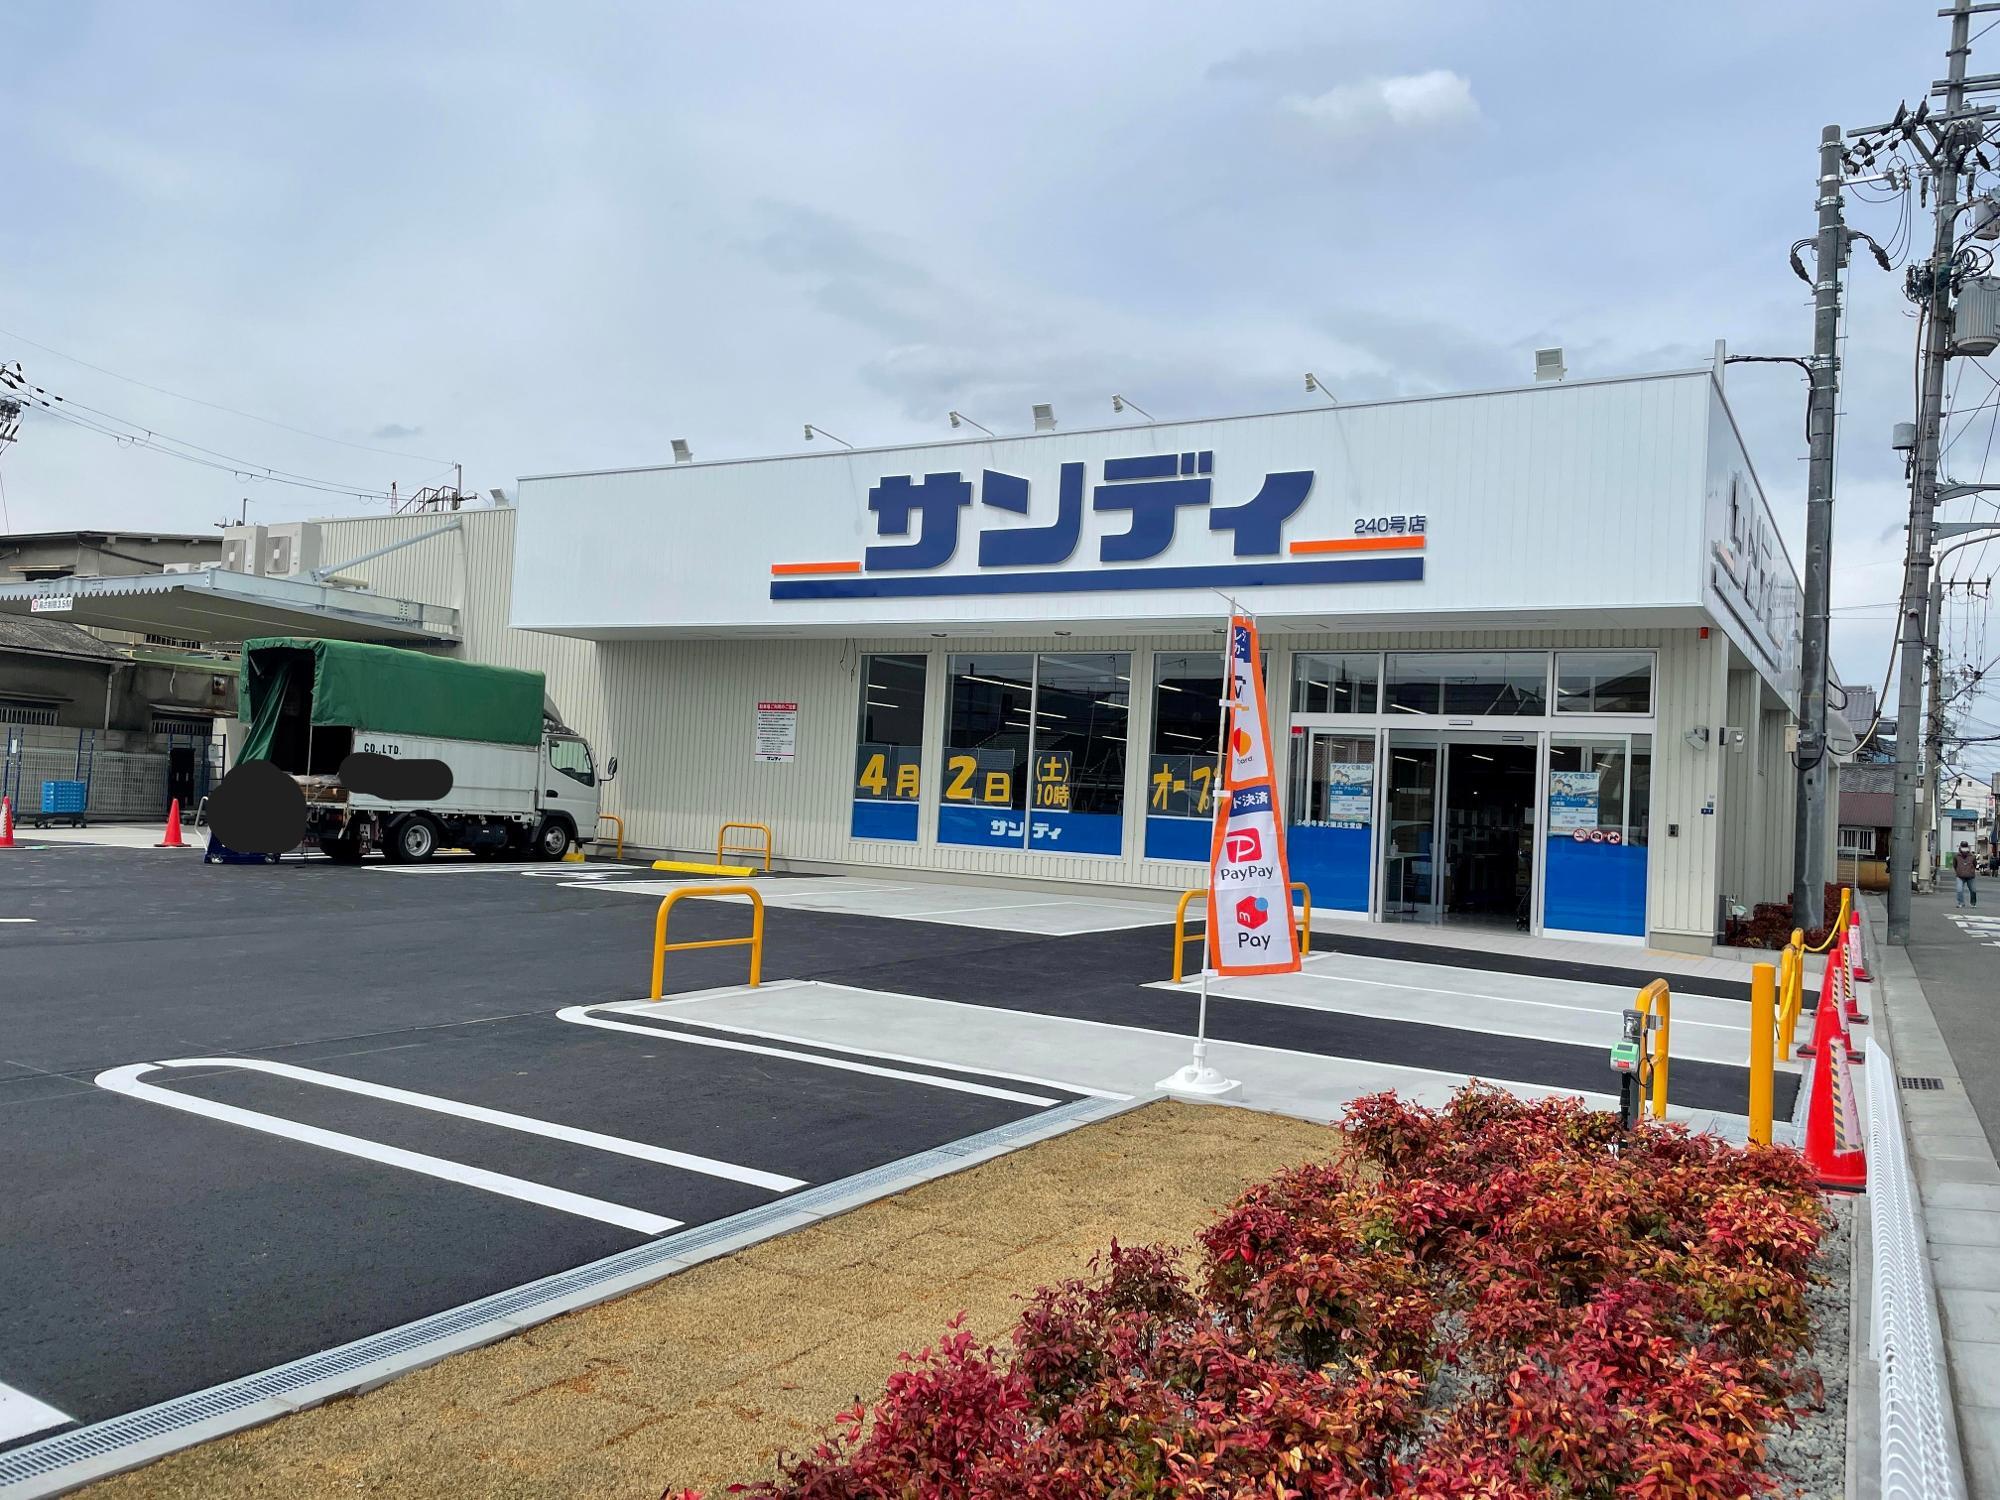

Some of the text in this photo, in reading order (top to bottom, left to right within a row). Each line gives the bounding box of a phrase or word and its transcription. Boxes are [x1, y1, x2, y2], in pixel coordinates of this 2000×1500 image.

[865, 450, 1315, 571] サンディ
[1354, 515, 1426, 534] 240号店
[859, 753, 920, 798] 4月
[946, 755, 1011, 803] 2日
[1153, 764, 1223, 813] オープ
[1036, 784, 1070, 807] 10時
[990, 819, 1062, 840] サンディ
[1220, 865, 1274, 882] PayPay
[1238, 932, 1271, 950] Pay
